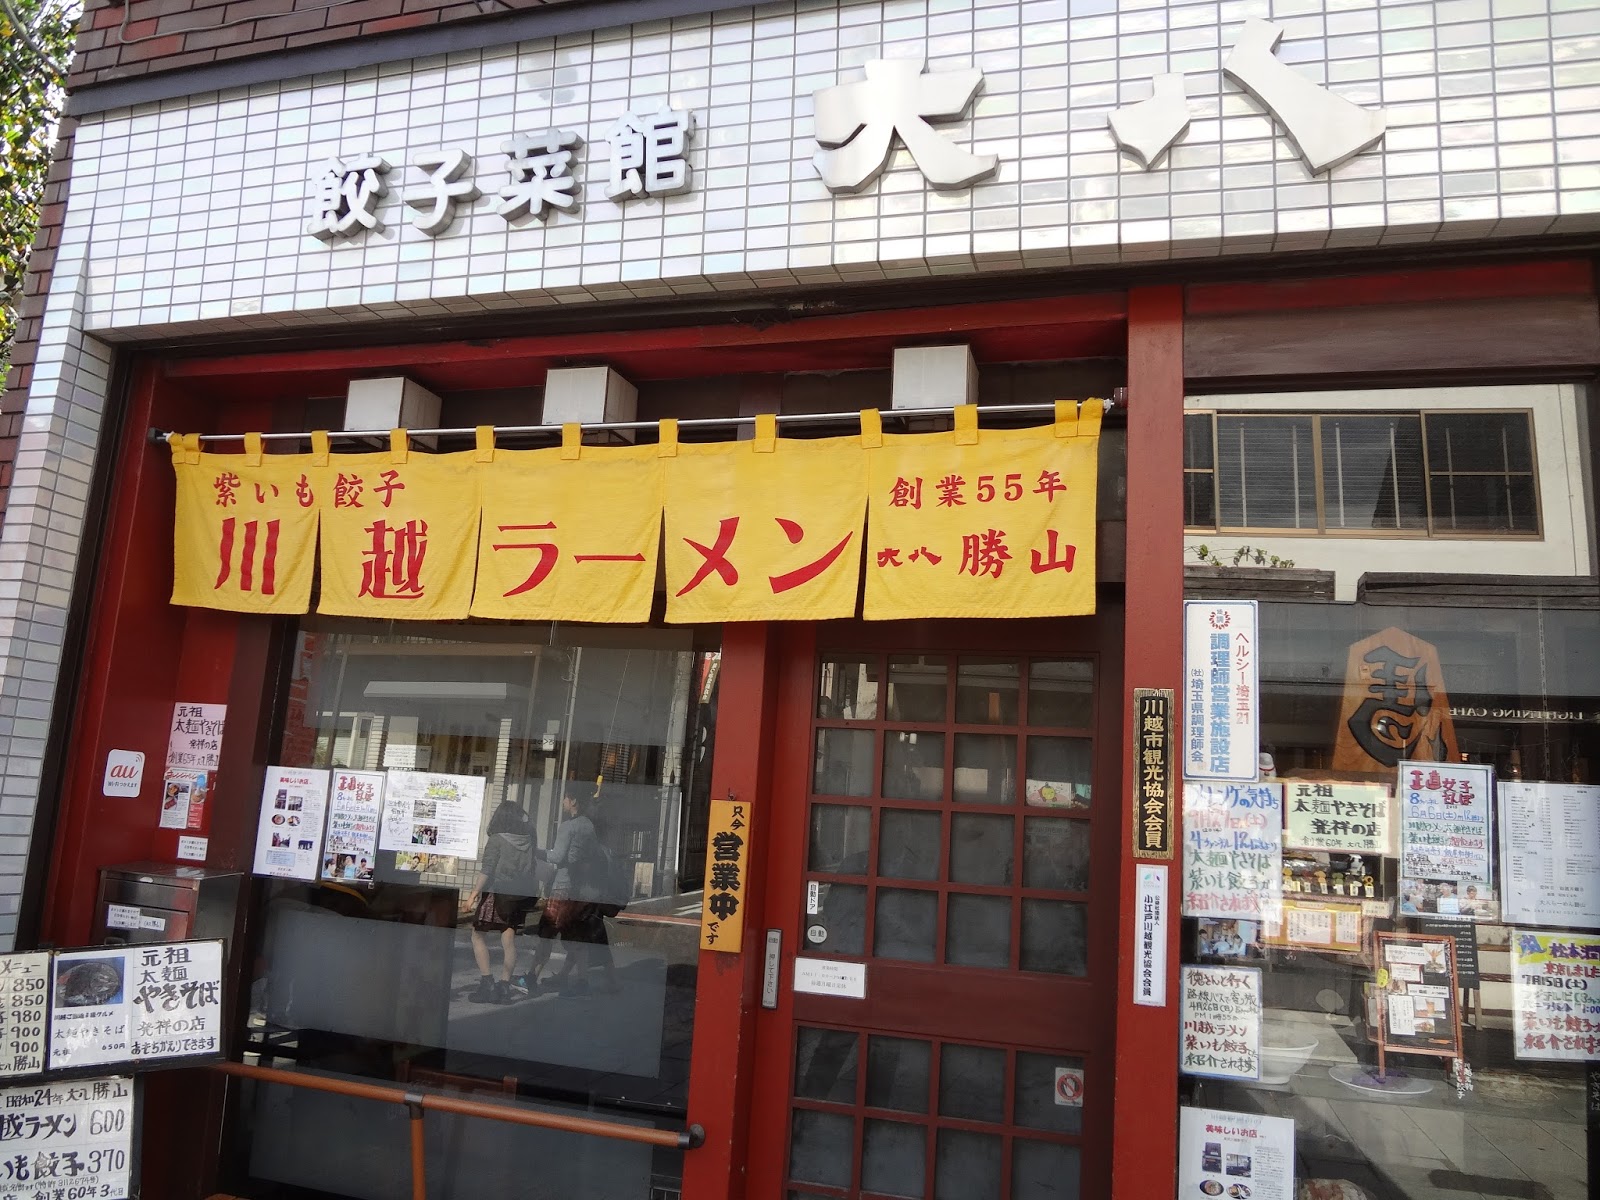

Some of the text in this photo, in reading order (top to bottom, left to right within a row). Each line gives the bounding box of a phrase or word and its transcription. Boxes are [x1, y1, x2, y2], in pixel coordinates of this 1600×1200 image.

[307, 105, 695, 240] 餃子菜館
[214, 470, 406, 509] 紫いも餃子
[889, 469, 1067, 510] 創業55年
[213, 515, 853, 600] 川越ラーメン
[1235, 632, 1250, 725] ヘルシー埼玉21
[178, 706, 203, 717] 元祖
[1210, 633, 1230, 773] 調理師営業施設店
[189, 739, 218, 750] 発祥の店
[110, 764, 139, 779] au
[1143, 700, 1164, 849] 川越市観光協会会員
[1296, 784, 1334, 797] 元祖
[730, 806, 745, 830] 只今
[1292, 798, 1387, 818] 太麺やきそば
[1309, 818, 1382, 837] 発祥の店
[708, 831, 744, 921] 営業中
[809, 883, 817, 910] 自動ドア
[706, 921, 719, 945] です
[810, 929, 825, 938] 自動
[1142, 894, 1153, 997] 小江戸川越観光協会会員
[141, 947, 192, 966] 元祖
[12, 978, 45, 992] 850
[137, 966, 189, 986] 太麺
[1522, 974, 1588, 990] 7月15日(土)
[11, 994, 44, 1008] 850
[133, 980, 220, 1013] やきそば
[11, 1009, 41, 1024] 980
[137, 1016, 206, 1036] 発祥の店
[10, 1026, 41, 1039] 900
[10, 1040, 39, 1054] 900
[6, 1088, 64, 1108] 昭和24年
[90, 1109, 125, 1135] 600
[1206, 1124, 1258, 1138] 美味しいお店
[87, 1148, 125, 1175] 370
